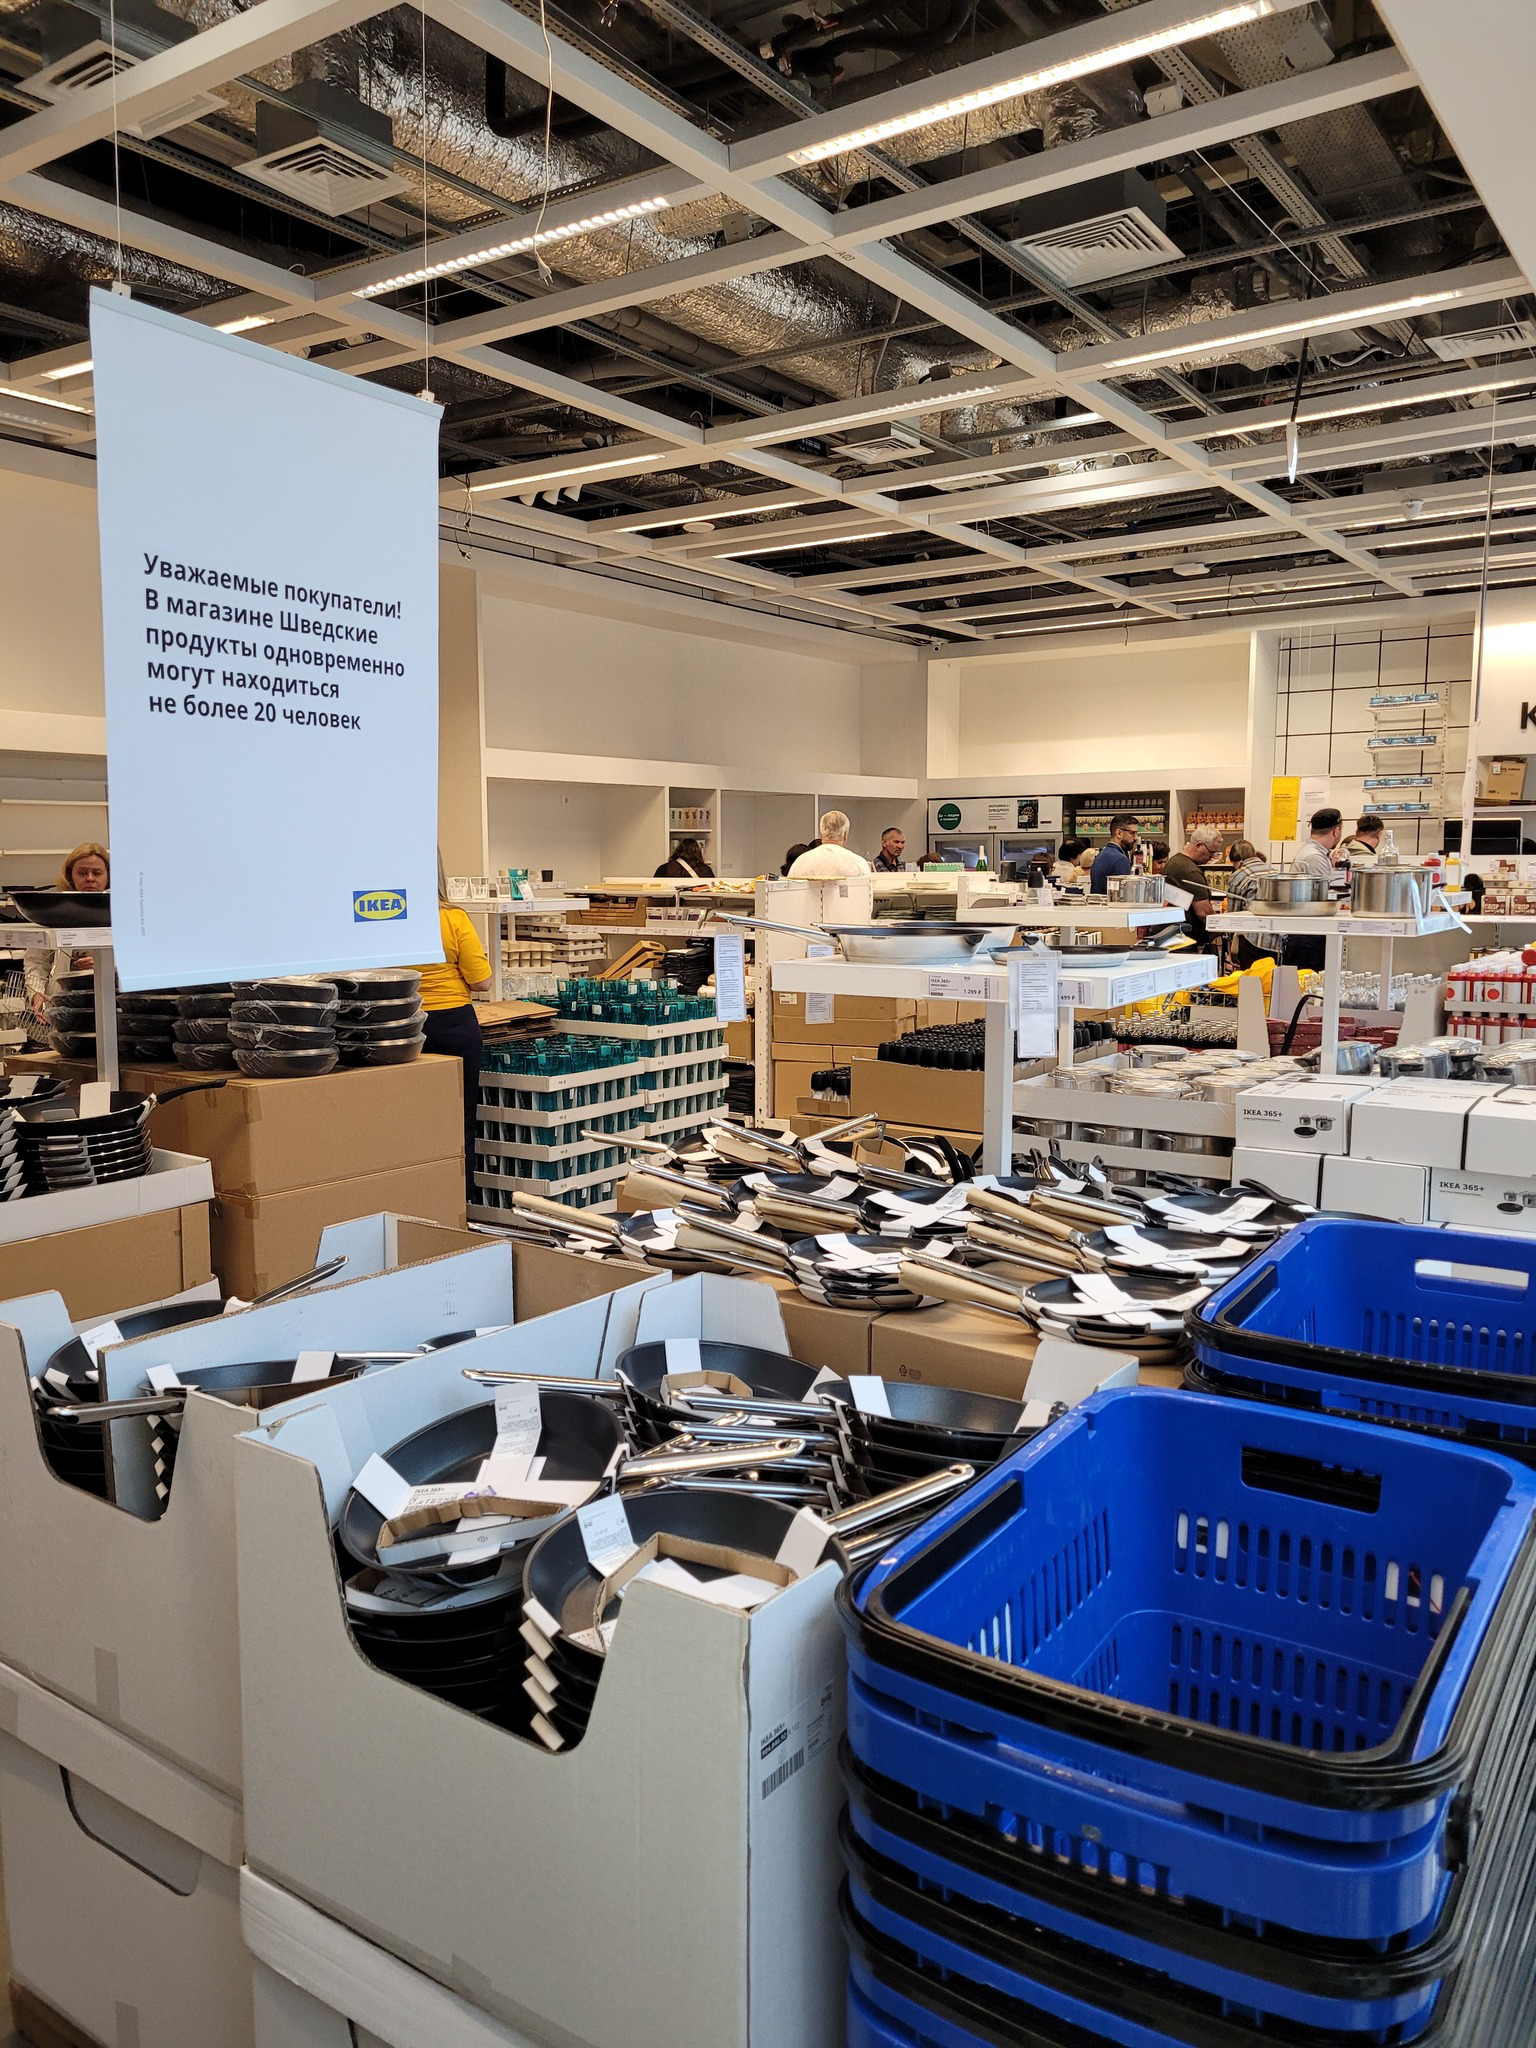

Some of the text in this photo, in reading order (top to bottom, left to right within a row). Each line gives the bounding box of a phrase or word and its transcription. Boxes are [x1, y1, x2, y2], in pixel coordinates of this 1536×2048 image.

[143, 552, 401, 619] Уважаемые покупатели!
[145, 588, 378, 645] В магазине Шведские
[146, 627, 405, 678] продукты одновременно
[147, 661, 340, 699] могут находиться
[149, 694, 362, 731] не более 20 человек
[359, 898, 403, 912] IKEA
[1243, 1108, 1262, 1116] IKEA
[1439, 1181, 1485, 1191] IKEA 365+
